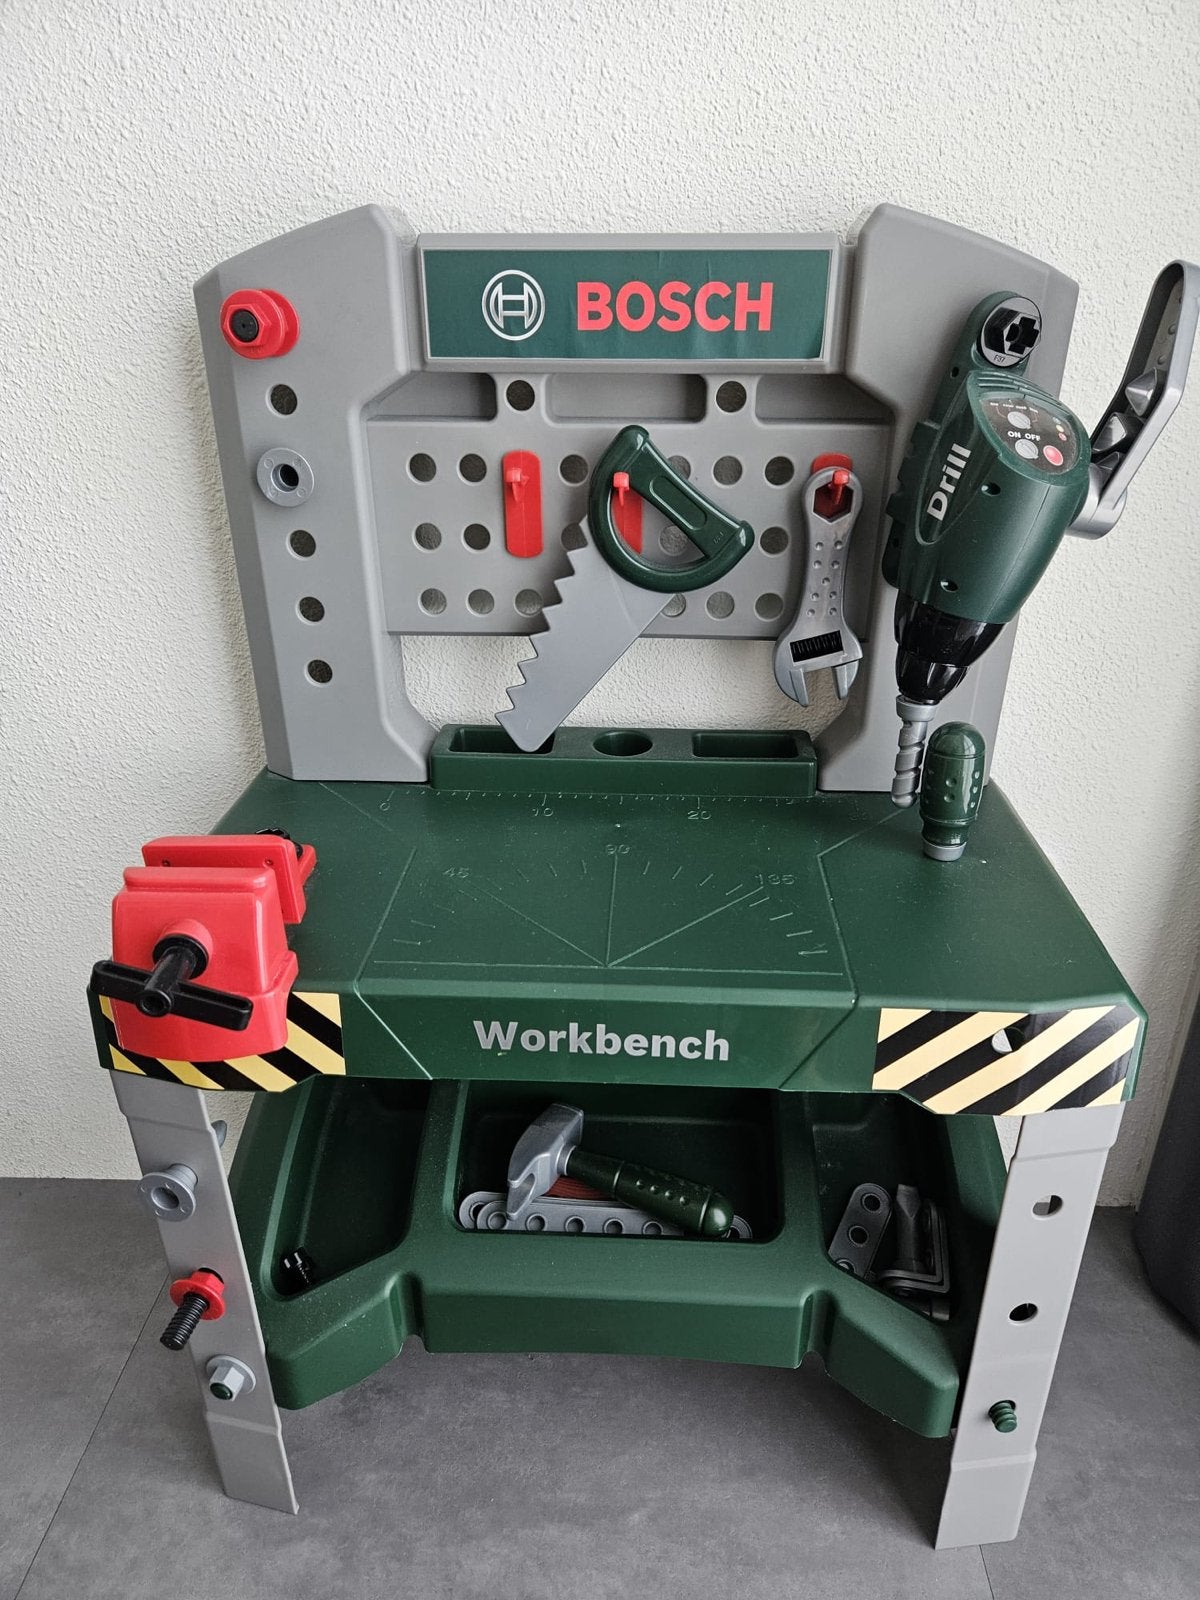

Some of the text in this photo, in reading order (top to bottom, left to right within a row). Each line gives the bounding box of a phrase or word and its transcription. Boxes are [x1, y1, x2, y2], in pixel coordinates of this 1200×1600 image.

[577, 281, 774, 332] BOSCH
[1007, 430, 1041, 442] ON OFF
[927, 443, 972, 521] Drill
[687, 810, 712, 820] 20
[605, 844, 631, 855] 90
[442, 867, 470, 878] 45
[754, 873, 796, 885] 135
[473, 1020, 730, 1062] Workbench
